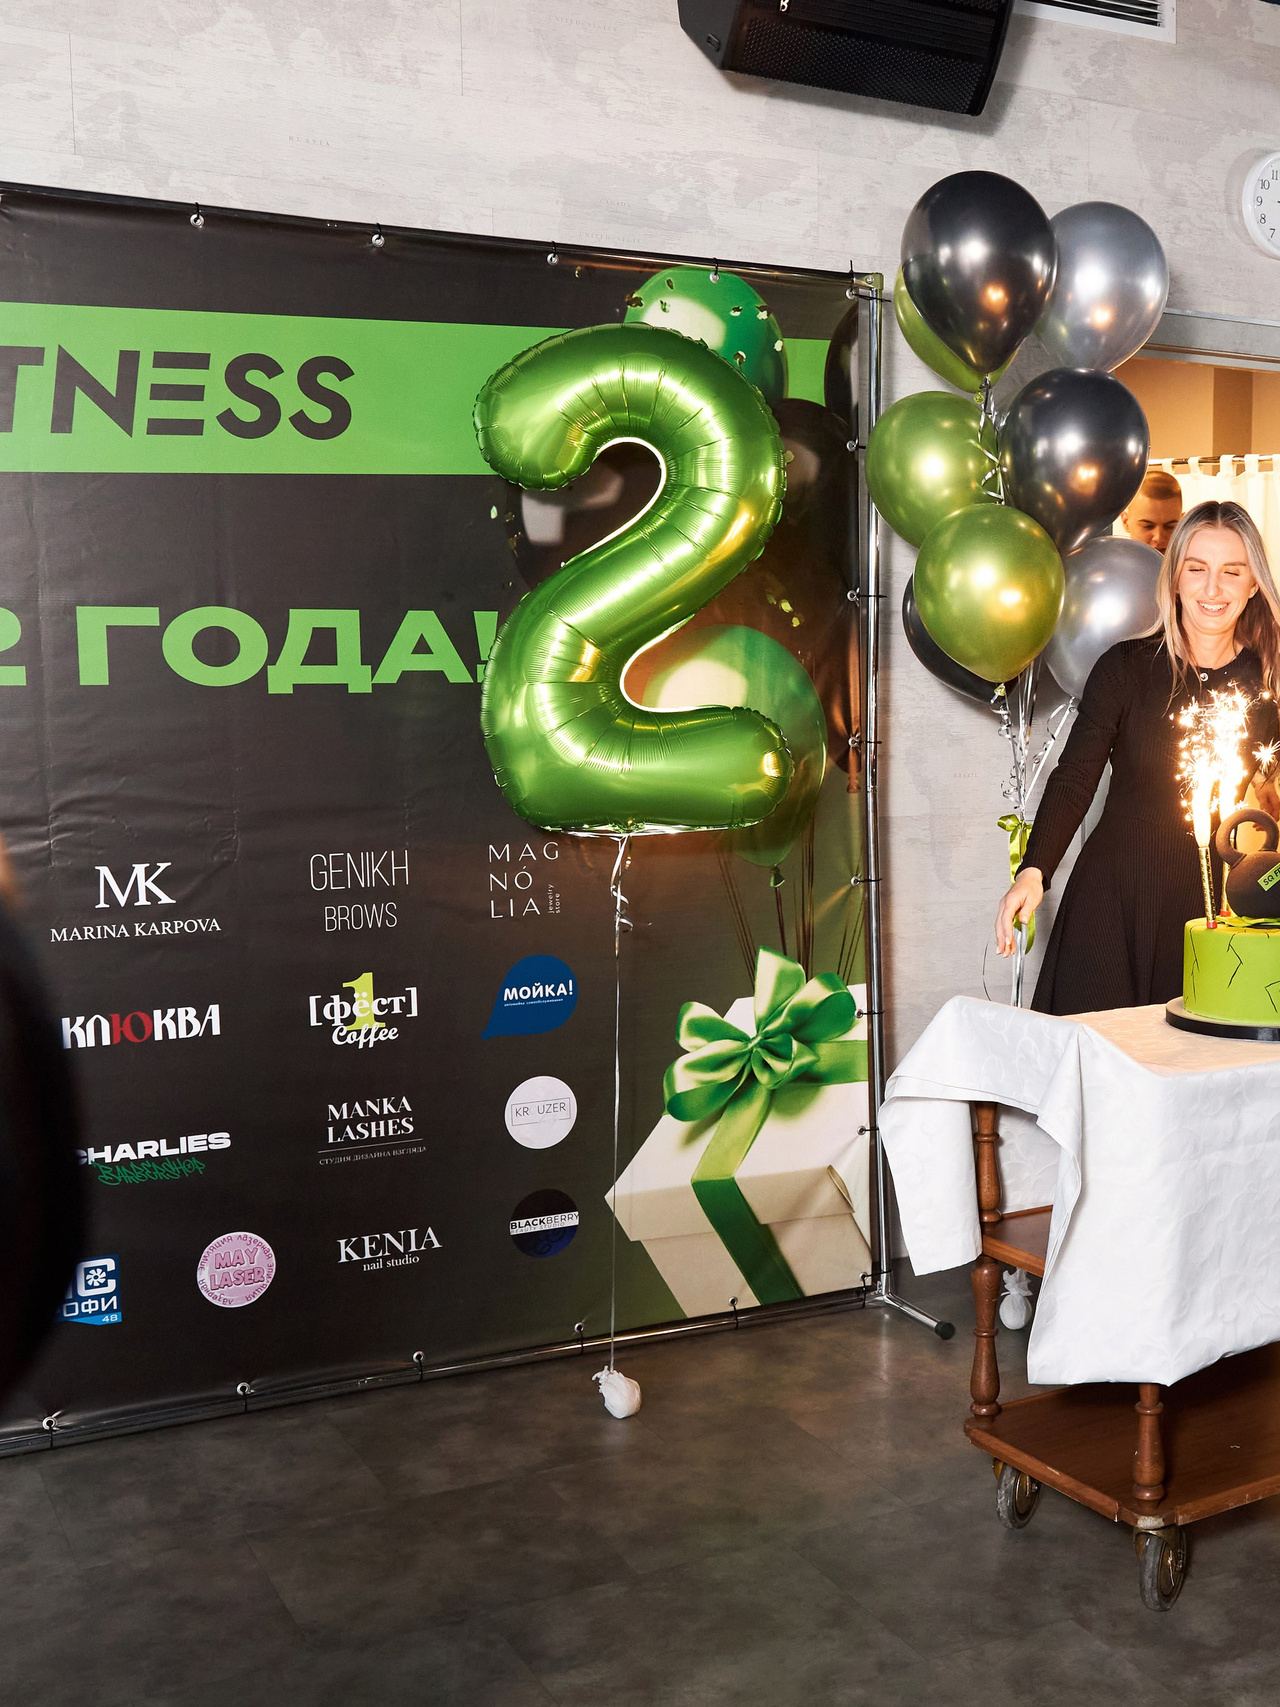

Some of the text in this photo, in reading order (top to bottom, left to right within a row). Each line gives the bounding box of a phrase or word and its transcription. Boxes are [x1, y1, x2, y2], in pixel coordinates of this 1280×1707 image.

[288, 135, 331, 147] RUSSIA
[1260, 179, 1271, 190] 10
[1271, 170, 1278, 180] 11
[1256, 196, 1263, 207] 9
[1260, 213, 1266, 224] 8
[1269, 228, 1276, 239] 7
[76, 606, 499, 693] ГОДА!
[489, 841, 559, 863] MAG
[310, 849, 409, 891] GENIKH
[490, 866, 533, 892] NÓ
[1263, 874, 1275, 886] SQ
[95, 862, 176, 909] MK
[491, 897, 541, 918] LIA
[547, 884, 555, 914] jewelry
[324, 902, 398, 932] BROWS
[50, 918, 222, 942] MARINA KARPOVA
[503, 979, 573, 1001] МОЙКА!
[61, 1004, 221, 1049] КЛЮКВА
[332, 1022, 399, 1049] Coffee
[327, 1096, 412, 1121] MANKA
[327, 1117, 414, 1144] LASHES
[319, 1156, 351, 1165] СТУДИЯ
[393, 1146, 427, 1156] ВЗГЛЯДА
[510, 1212, 579, 1230] BLACKBERRY
[336, 1226, 443, 1263] KENIA
[215, 1247, 258, 1269] MAY
[363, 1254, 420, 1271] nail studio
[210, 1267, 265, 1291] LASER
[102, 1314, 118, 1322] 48
